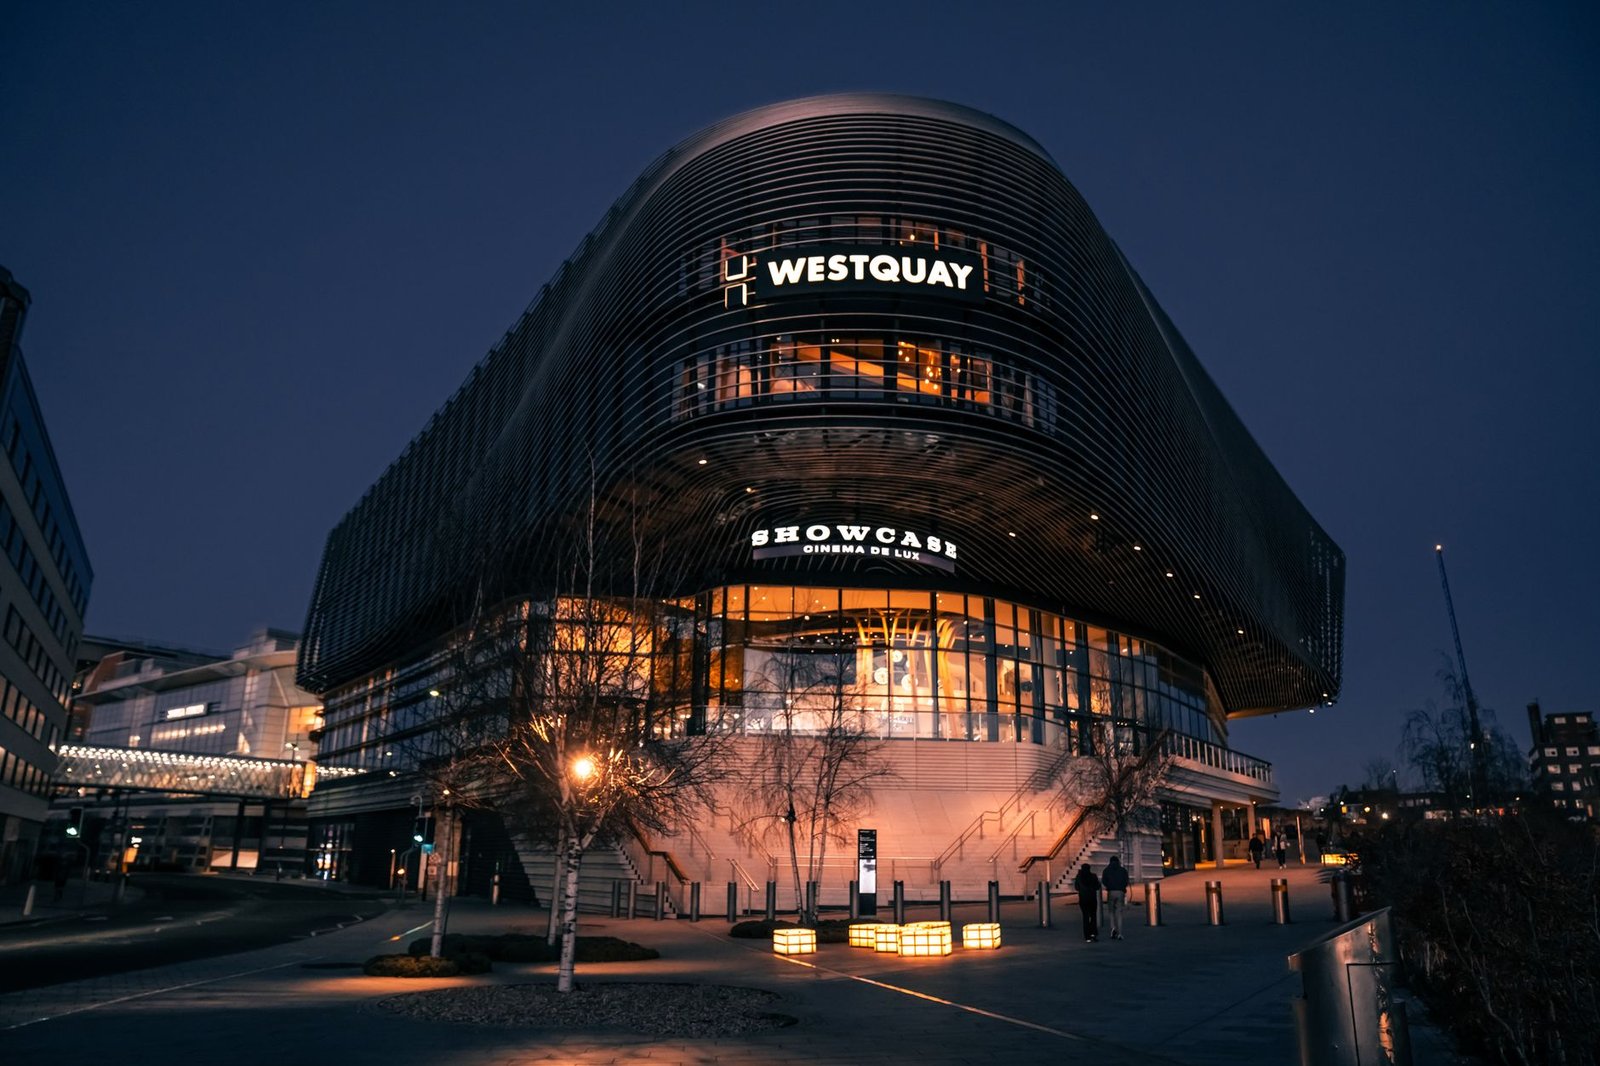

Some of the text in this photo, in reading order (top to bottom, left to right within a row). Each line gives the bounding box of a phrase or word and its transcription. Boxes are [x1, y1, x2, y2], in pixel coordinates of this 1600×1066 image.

[767, 254, 974, 290] WESTQUAY
[751, 524, 957, 560] SHOWCASE
[802, 544, 920, 561] CINEMA DE LUX
